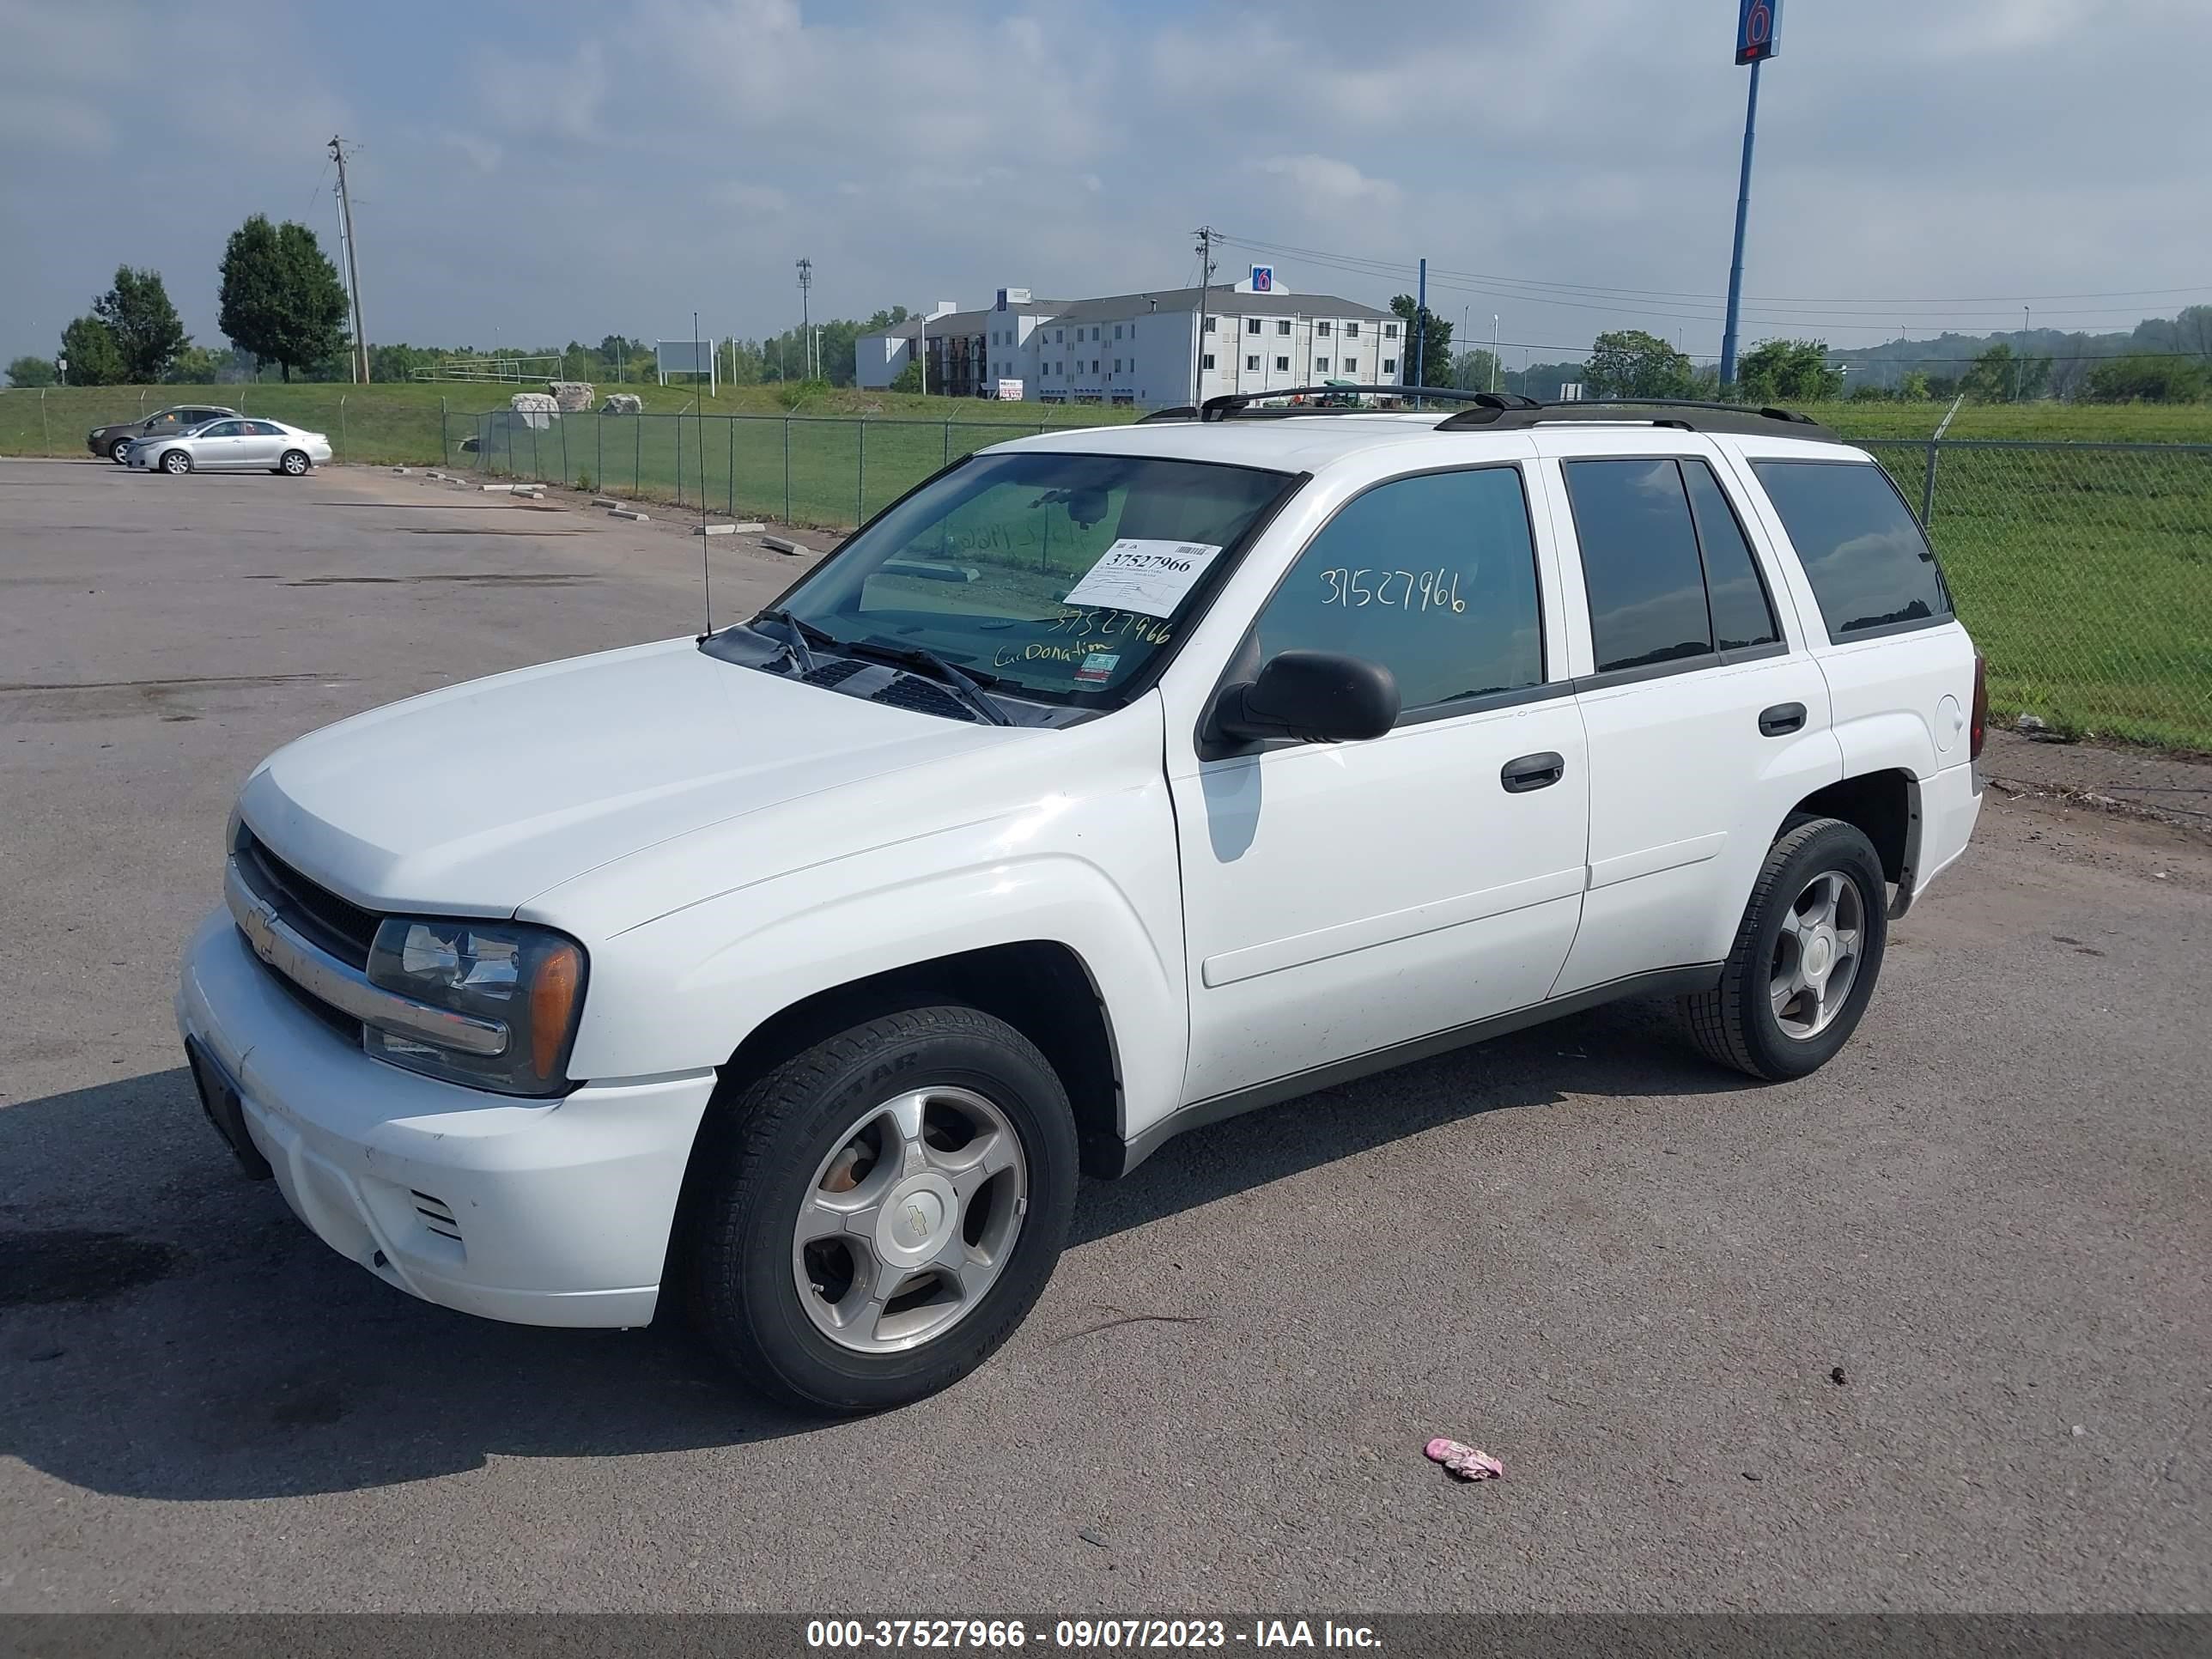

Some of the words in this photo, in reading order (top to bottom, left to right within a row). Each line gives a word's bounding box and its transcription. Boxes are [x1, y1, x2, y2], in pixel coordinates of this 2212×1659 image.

[1747, 0, 1771, 46] 6
[1258, 270, 1270, 290] 6
[1106, 553, 1195, 573] 37527966
[1320, 568, 1465, 613] 37527966
[1048, 608, 1173, 644] 37527966
